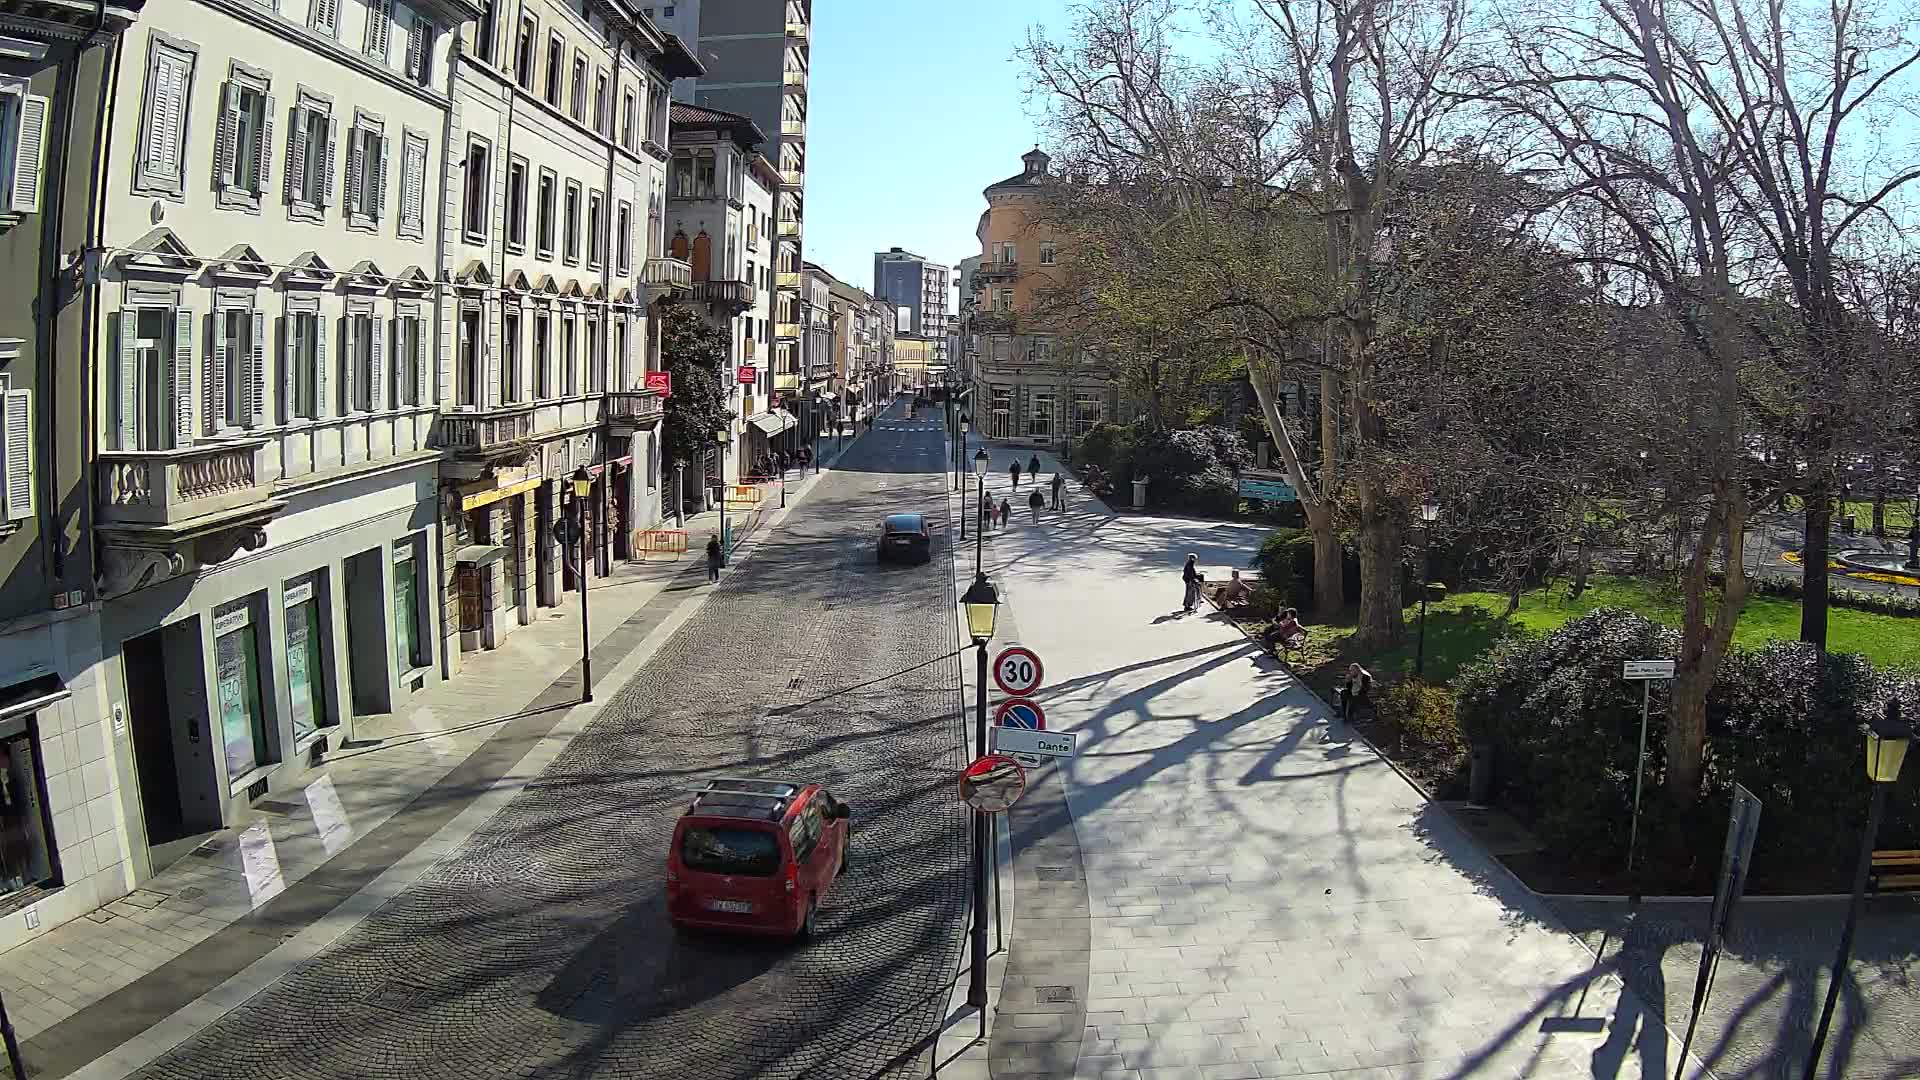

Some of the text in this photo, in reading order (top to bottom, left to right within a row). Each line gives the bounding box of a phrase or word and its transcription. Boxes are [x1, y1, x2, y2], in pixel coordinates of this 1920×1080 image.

[215, 613, 244, 631] OPERATIVO
[1005, 660, 1033, 684] 30
[1038, 740, 1070, 753] Dante
